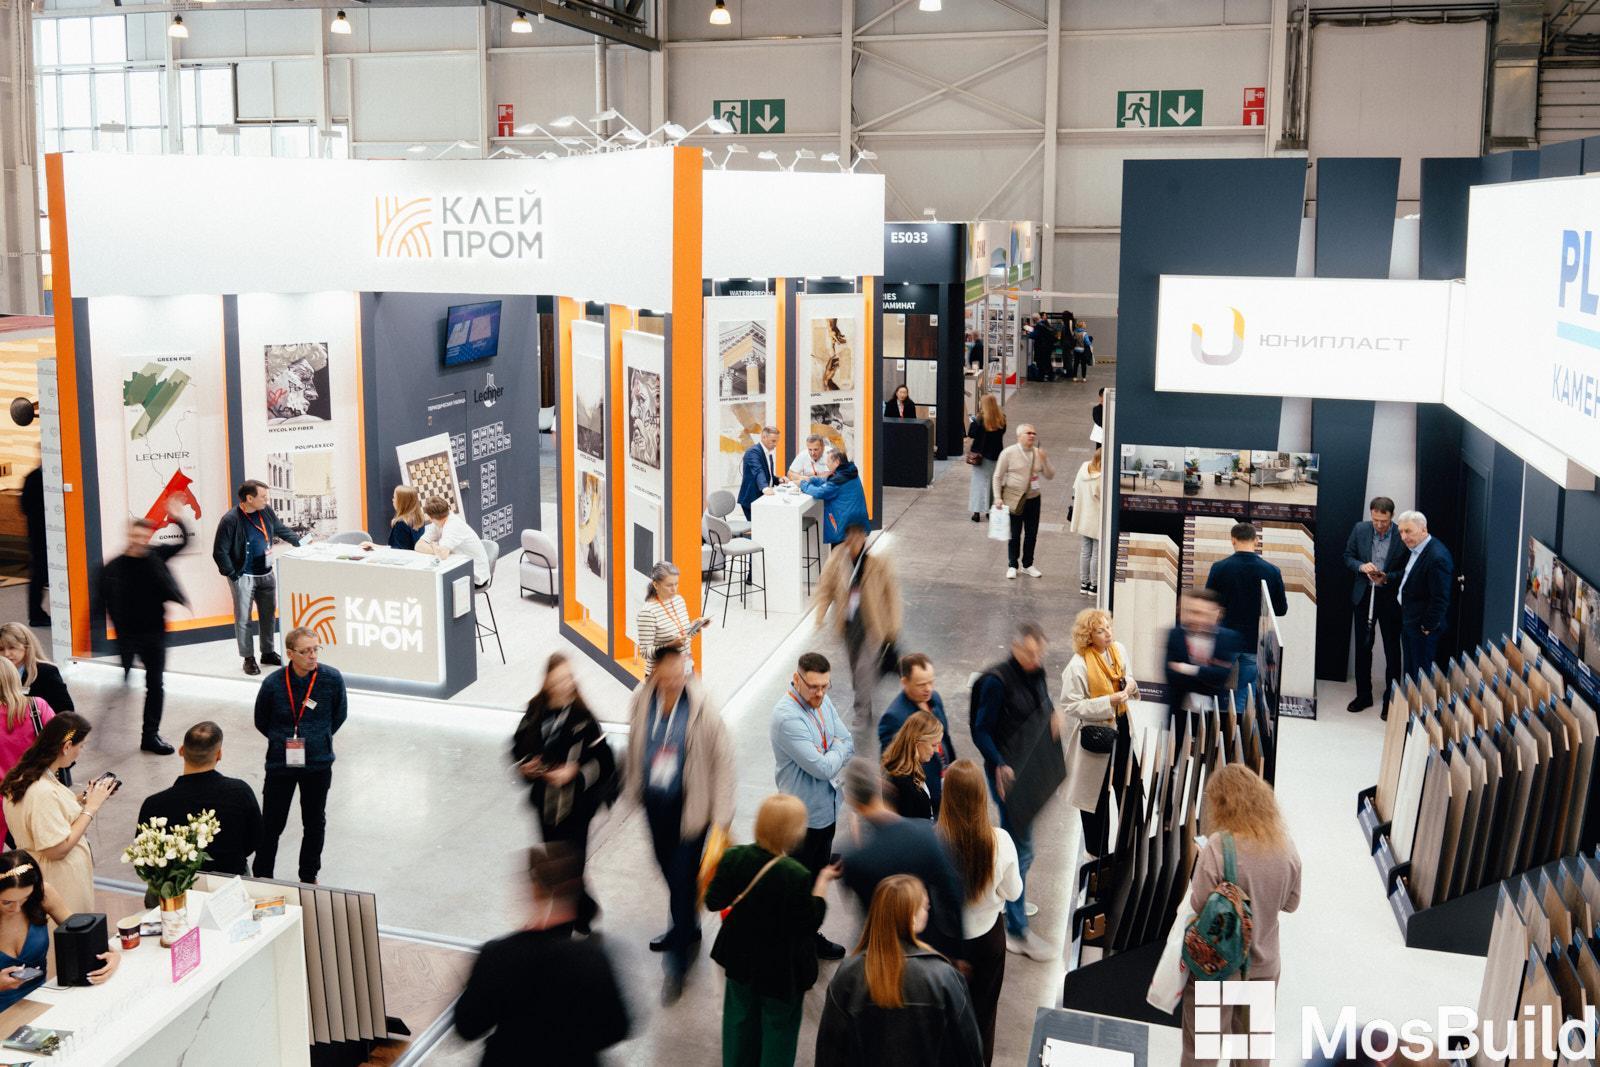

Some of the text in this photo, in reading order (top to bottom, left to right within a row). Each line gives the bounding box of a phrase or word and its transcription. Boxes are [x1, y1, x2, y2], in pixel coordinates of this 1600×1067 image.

[442, 189, 543, 225] КЛЕЙ
[443, 230, 543, 259] ПРОМ
[890, 231, 929, 244] E5033
[1259, 333, 1411, 352] ЮНИПЛАСТ
[135, 451, 190, 462] LECHNER
[344, 596, 423, 627] КЛЕЙ
[346, 622, 424, 653] ПРОМ
